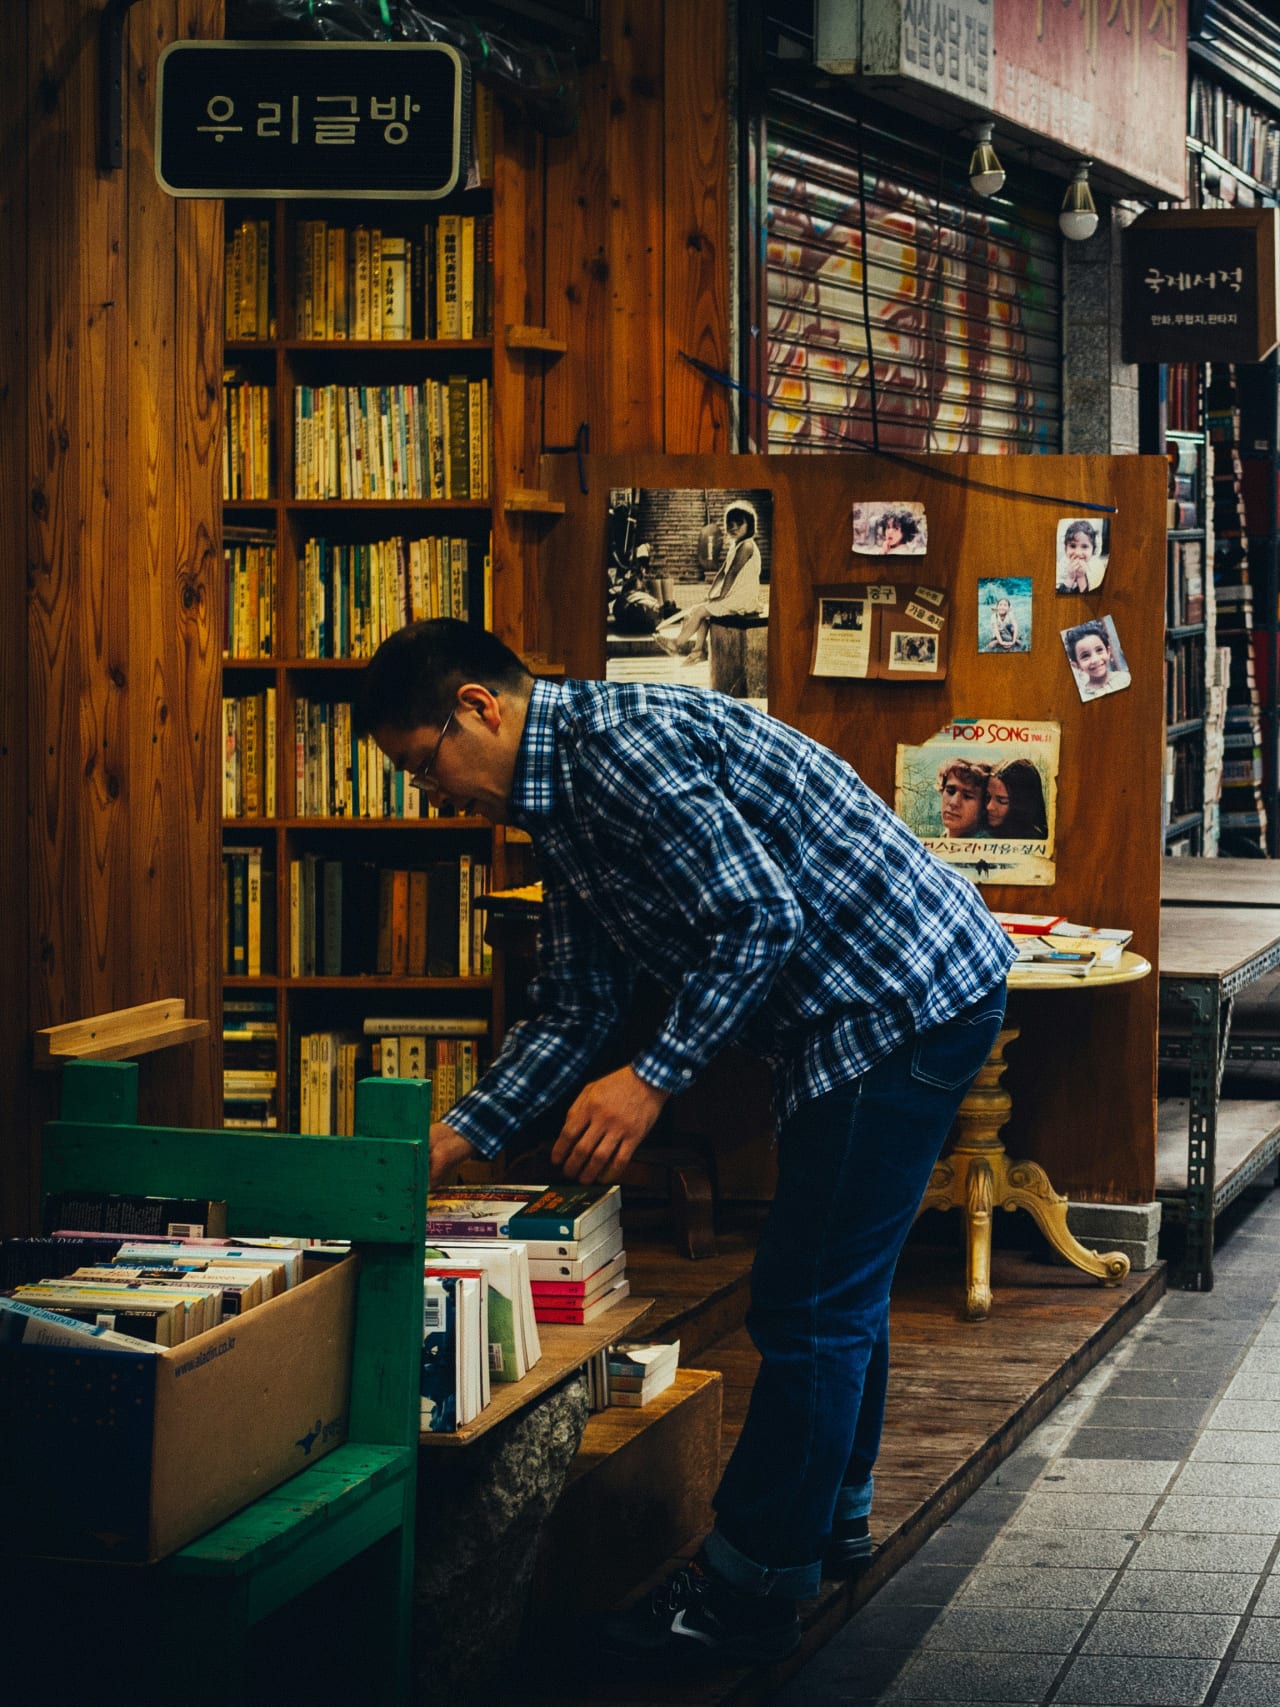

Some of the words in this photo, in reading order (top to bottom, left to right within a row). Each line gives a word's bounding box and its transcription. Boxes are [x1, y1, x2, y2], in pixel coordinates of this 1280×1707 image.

[196, 94, 421, 145] 우리글방
[1144, 267, 1243, 294] 국제서적
[952, 725, 985, 741] POP
[986, 723, 1030, 744] SONG
[25, 1236, 53, 1244] ANNE
[54, 1236, 84, 1245] TYLER
